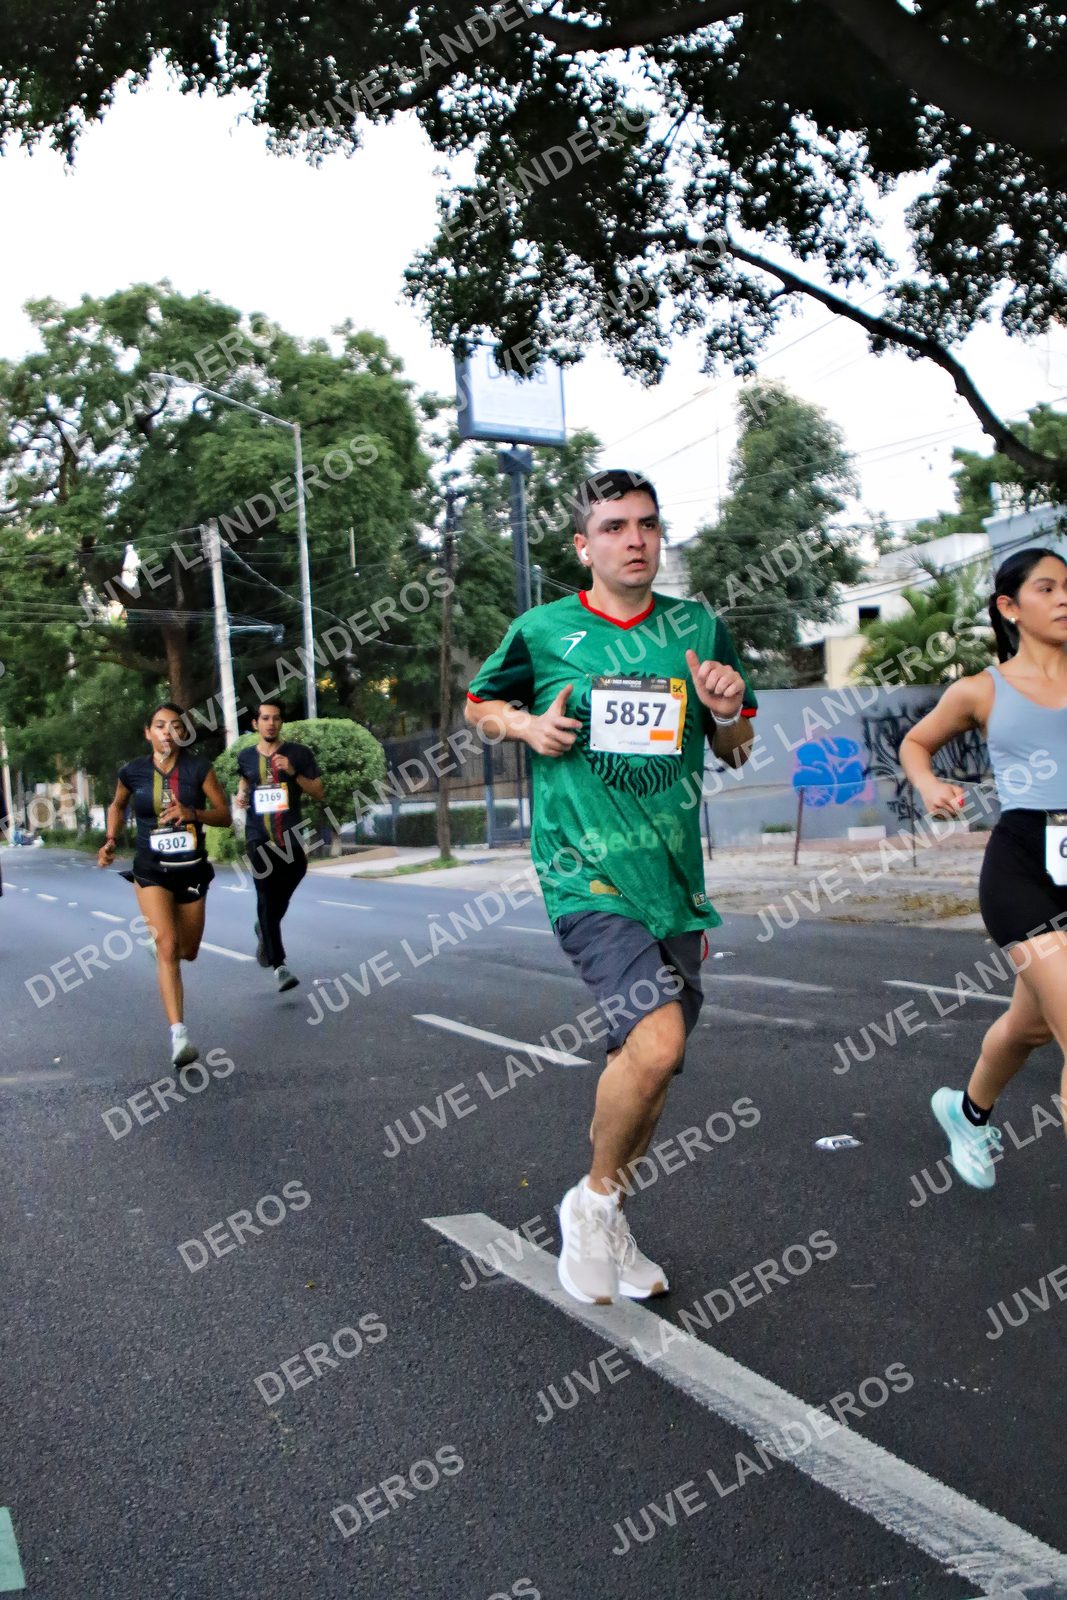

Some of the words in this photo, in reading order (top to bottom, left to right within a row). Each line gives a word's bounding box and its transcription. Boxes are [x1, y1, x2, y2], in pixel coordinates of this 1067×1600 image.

[604, 700, 667, 726] 5857
[259, 792, 282, 802] 2169
[157, 836, 187, 851] 6302
